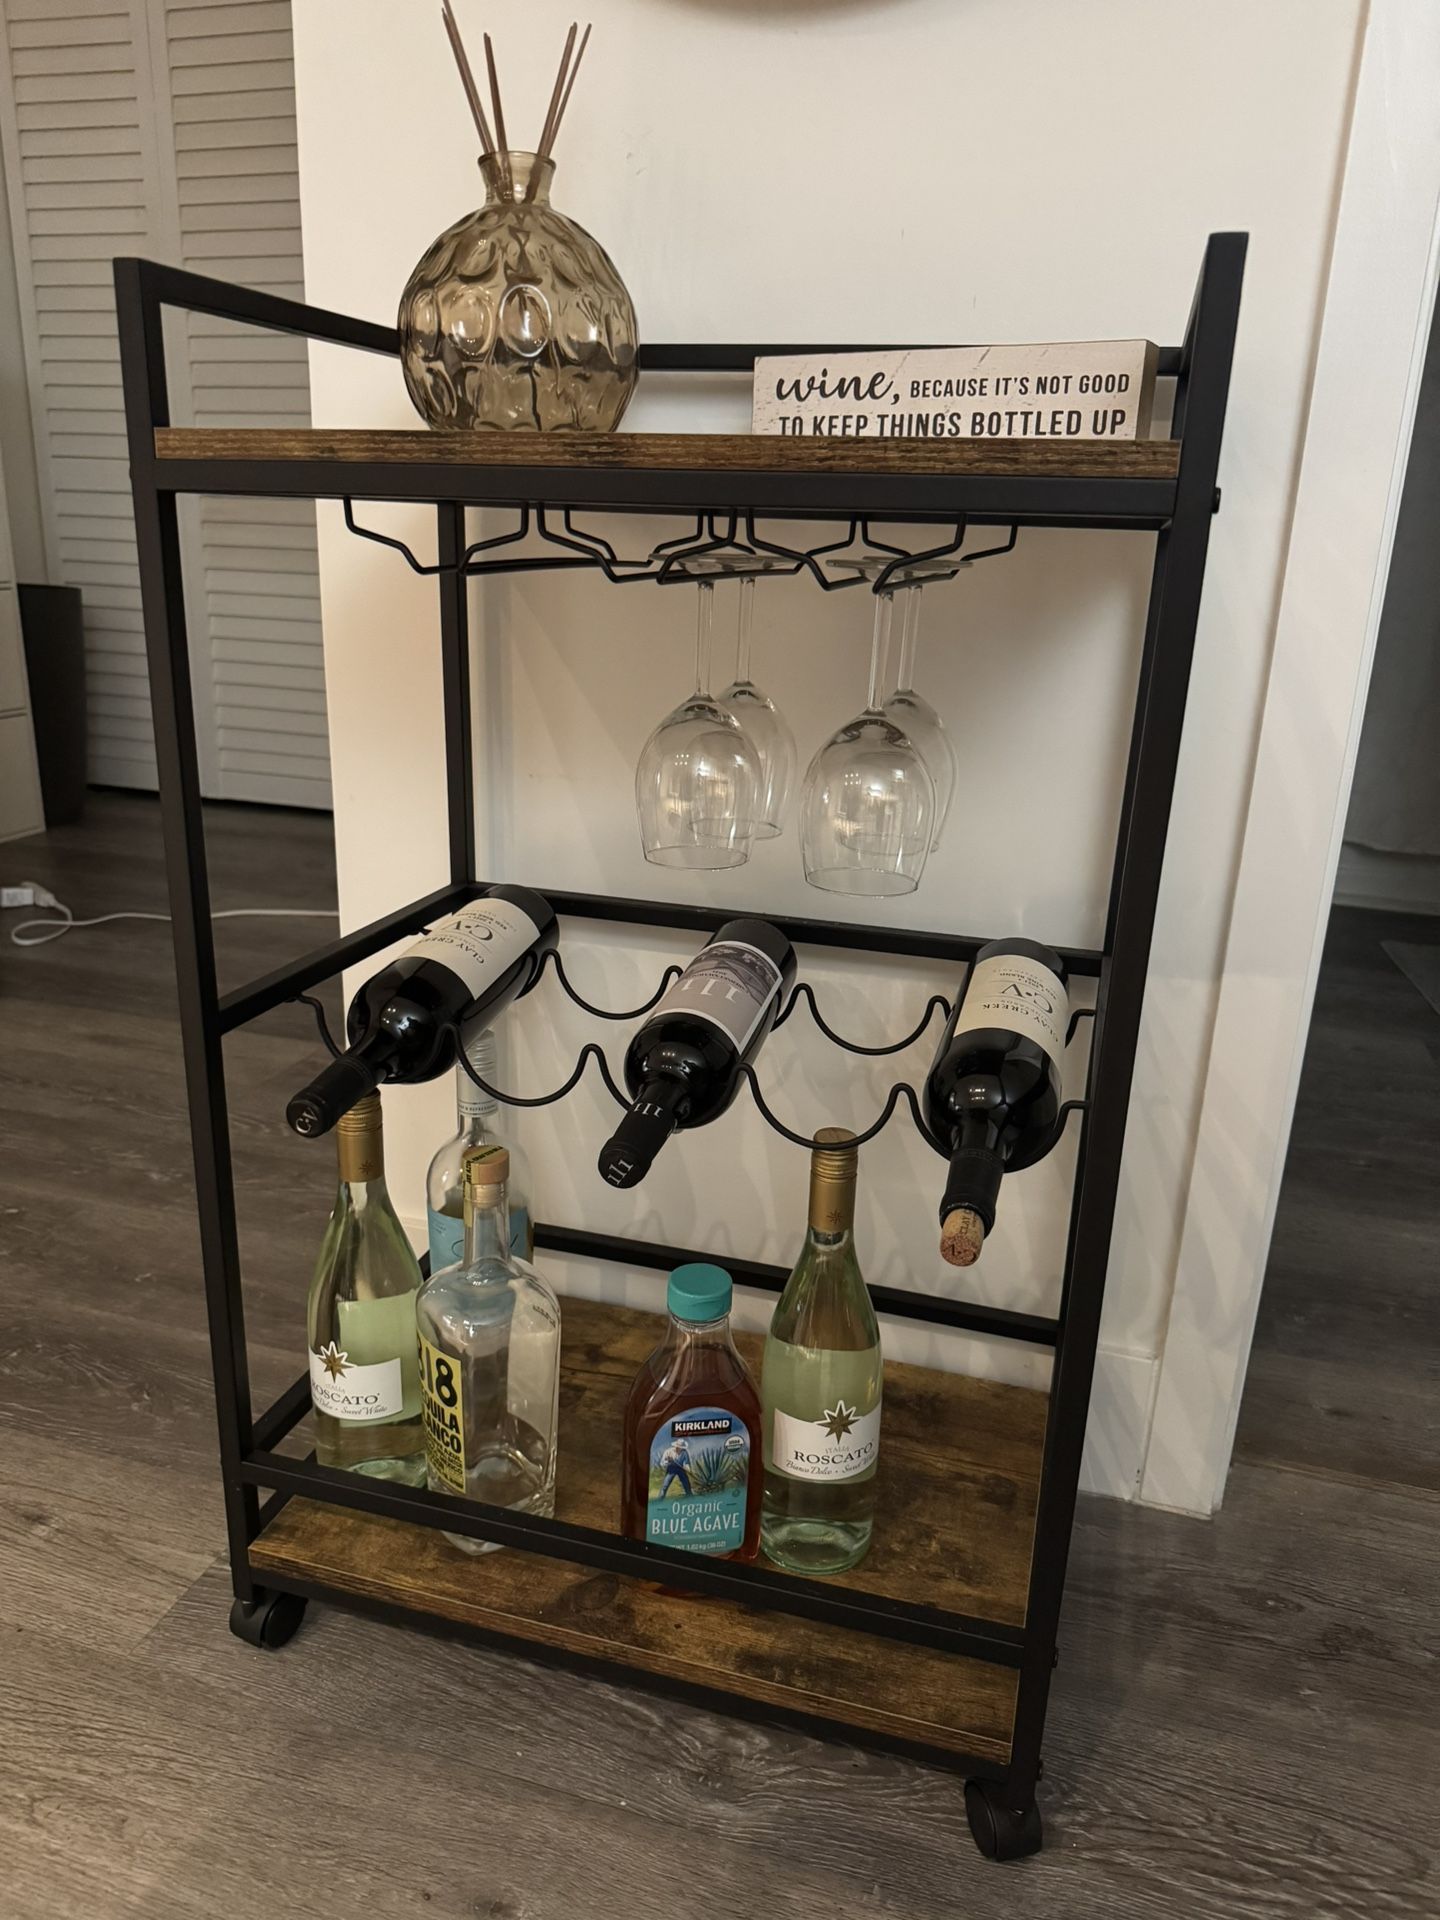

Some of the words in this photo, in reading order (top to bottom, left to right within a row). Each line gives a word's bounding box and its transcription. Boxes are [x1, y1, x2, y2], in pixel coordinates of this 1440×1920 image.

[776, 368, 901, 405] wine,
[910, 377, 987, 398] BECAUSE
[995, 376, 1029, 396] IT'S
[1036, 375, 1074, 395] NOT
[1079, 374, 1130, 394] GOOD
[778, 416, 803, 436] TO
[813, 415, 869, 437] KEEP
[878, 412, 961, 438] THINGS
[971, 410, 1081, 437] BOTTLED
[1093, 409, 1126, 435] UP
[421, 1384, 461, 1434] EQUILA
[423, 1403, 462, 1454] ANCO
[675, 1420, 730, 1431] KIRKLAND
[794, 1442, 873, 1465] ROSCATO
[671, 1501, 723, 1516] Organic
[651, 1516, 688, 1535] BLUE
[693, 1512, 740, 1533] AGAVE
